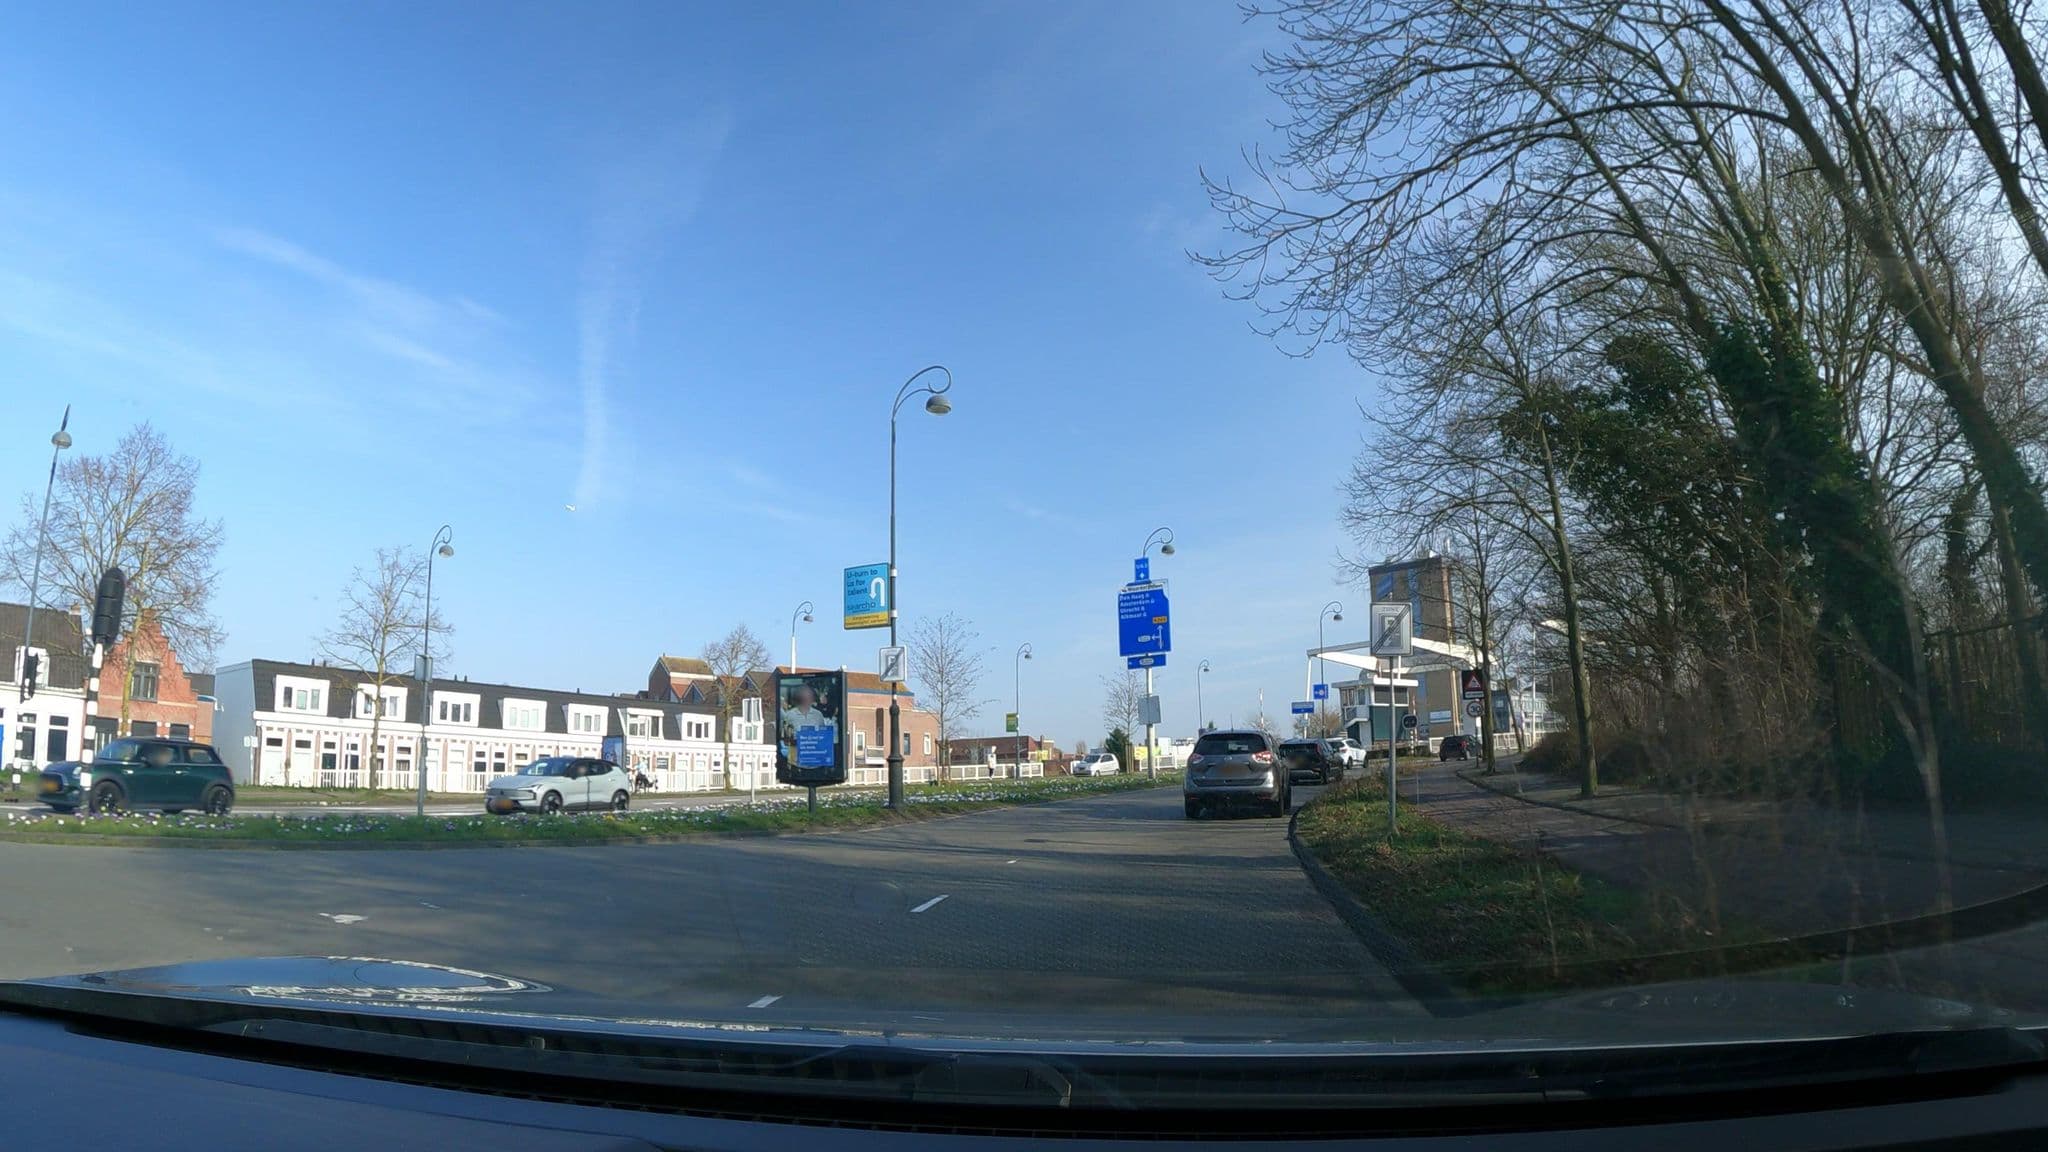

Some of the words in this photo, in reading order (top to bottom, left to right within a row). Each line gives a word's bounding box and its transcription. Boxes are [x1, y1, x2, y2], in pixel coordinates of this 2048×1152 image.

[847, 570, 869, 578] U-turn
[855, 579, 866, 587] for
[847, 587, 868, 596] talent
[1119, 599, 1150, 607] Amsterdam
[1470, 705, 1481, 713] 30
